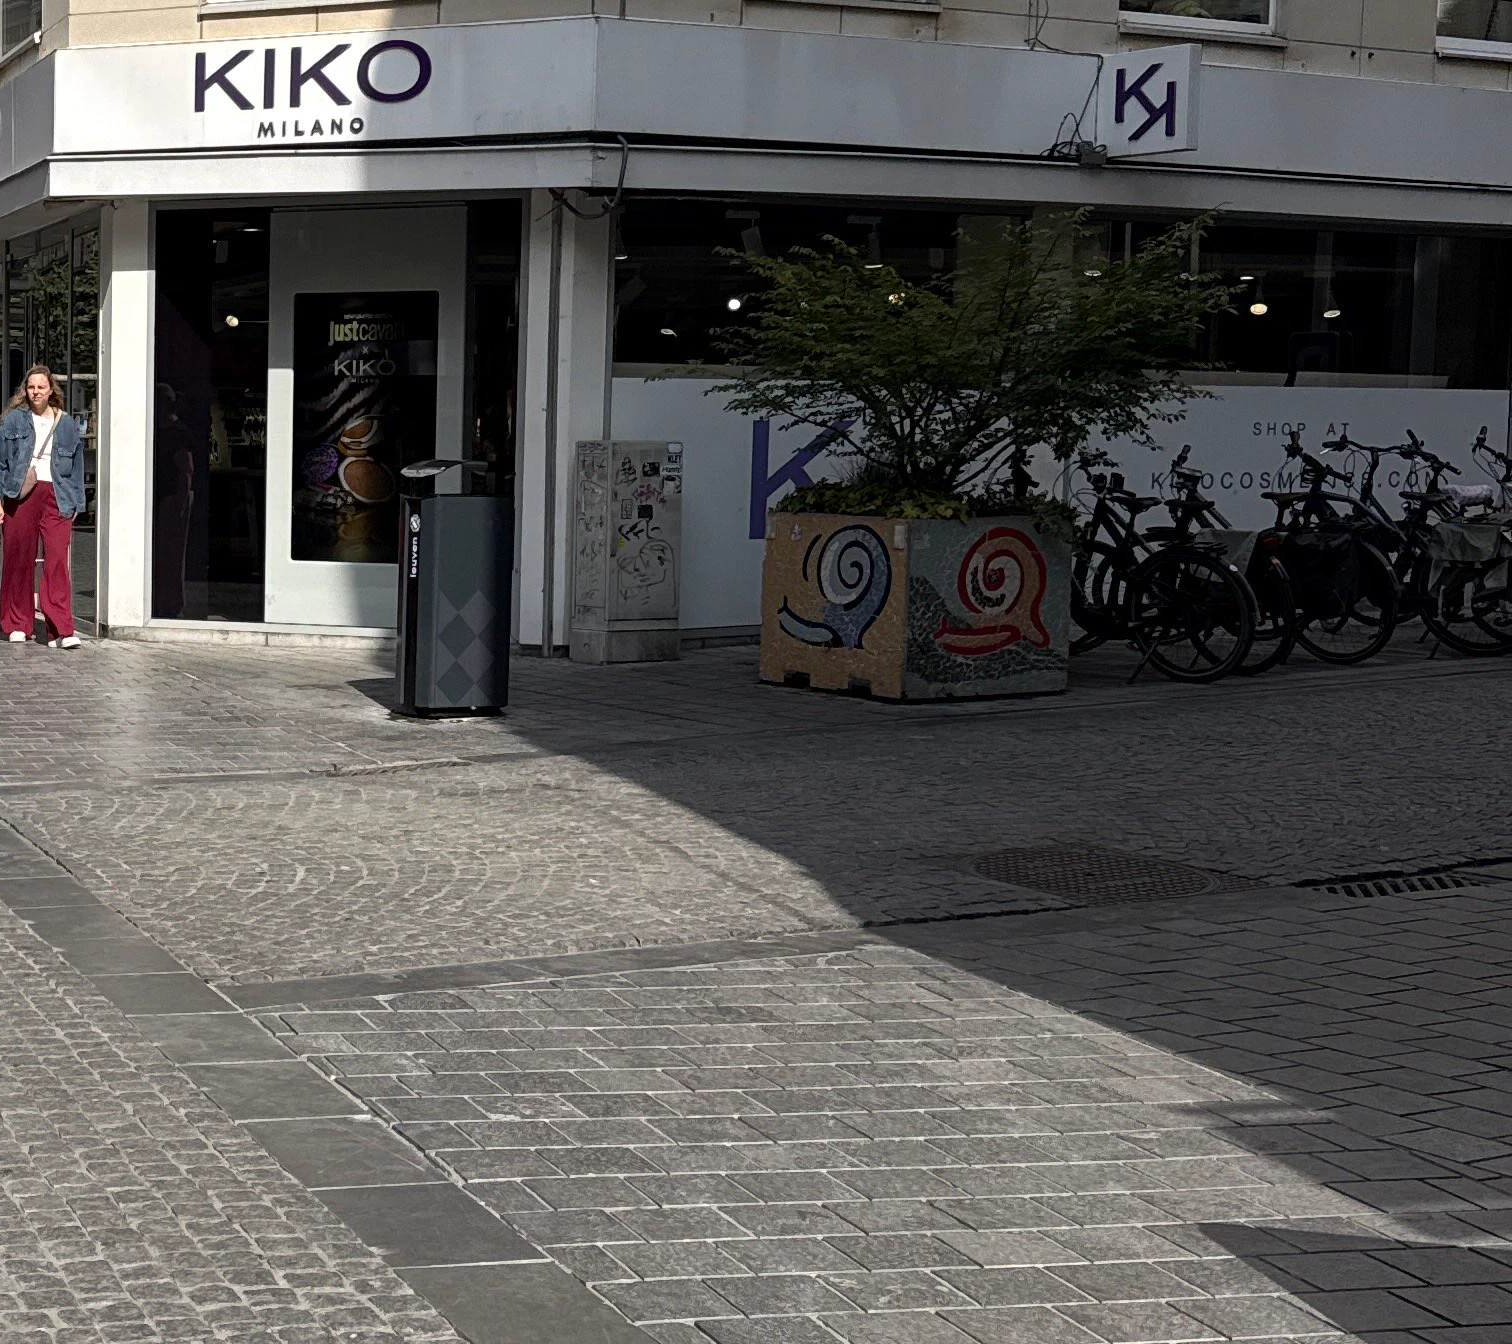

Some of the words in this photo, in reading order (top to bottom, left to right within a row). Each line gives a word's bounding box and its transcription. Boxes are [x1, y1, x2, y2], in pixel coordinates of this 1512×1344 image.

[194, 39, 433, 113] KIKO
[257, 117, 365, 139] MILANO
[334, 359, 397, 377] KIKO
[1253, 422, 1306, 437] SHOP
[1326, 422, 1350, 437] AT
[409, 536, 418, 578] leuven
